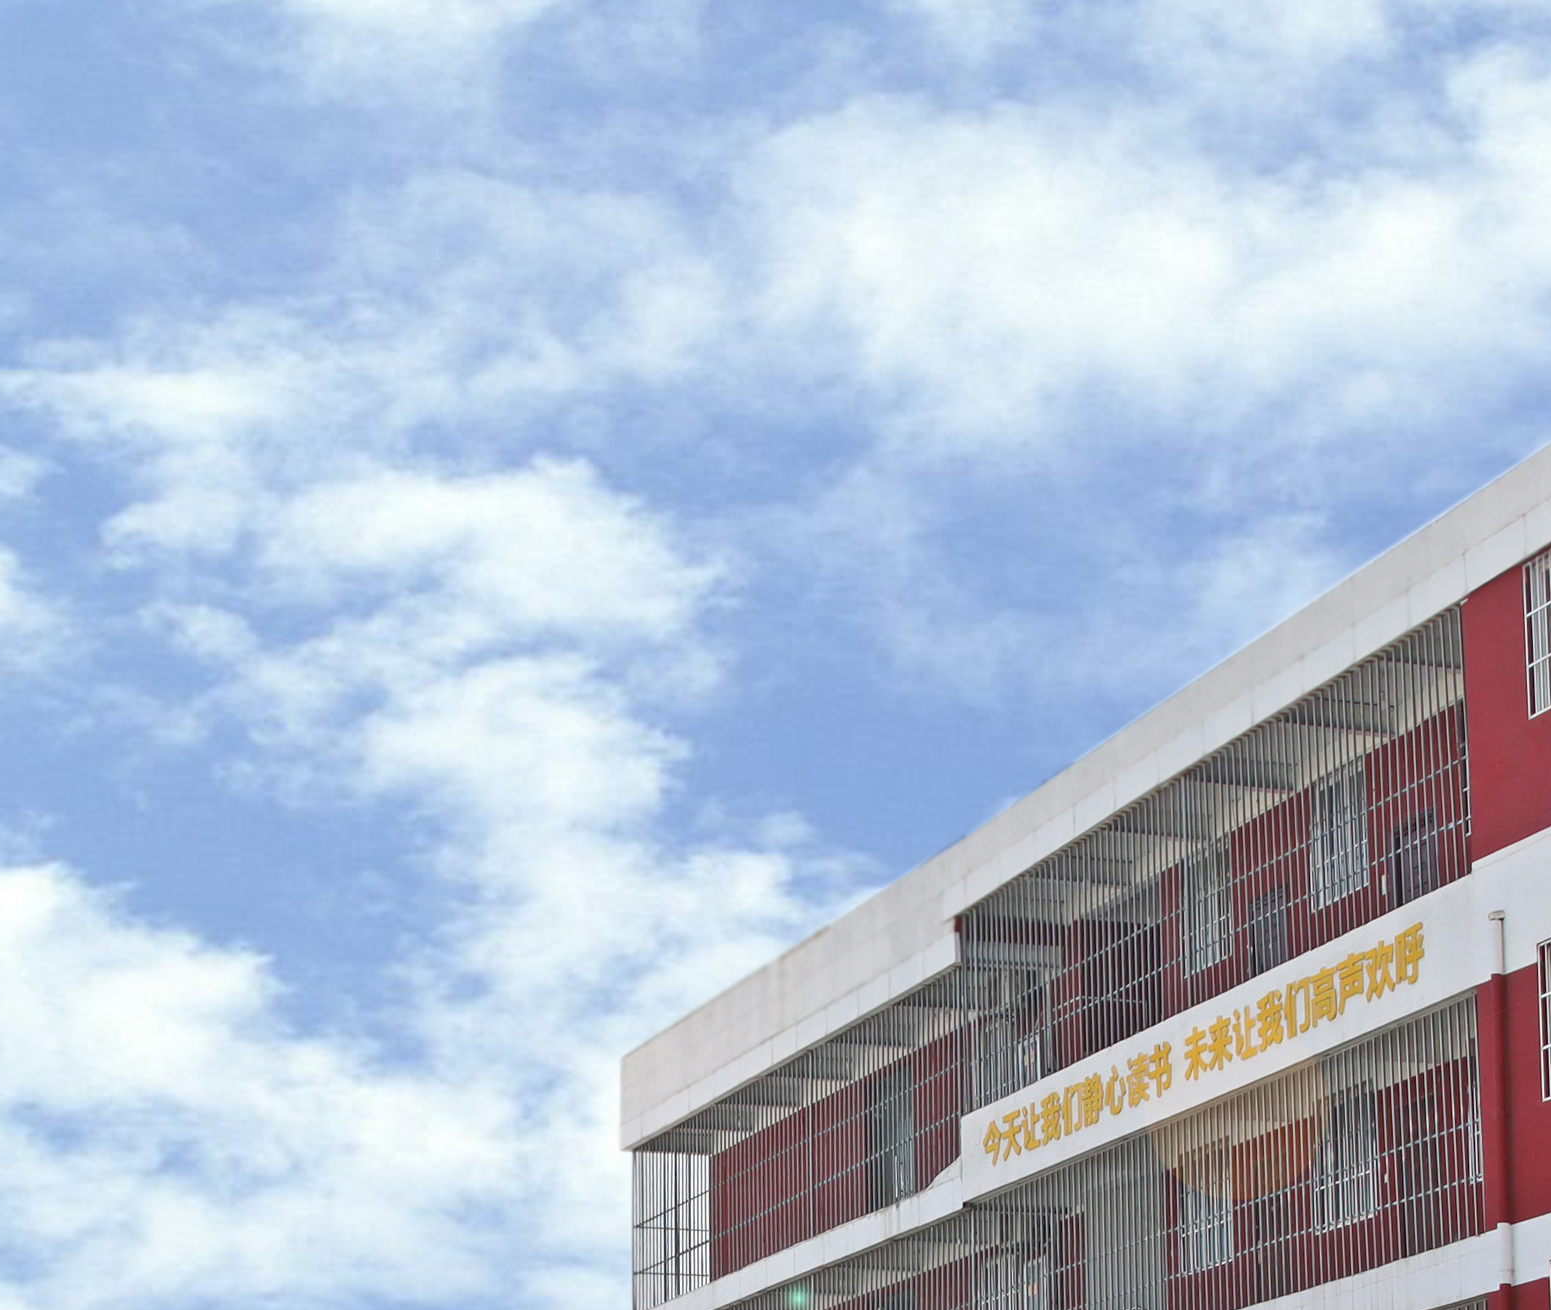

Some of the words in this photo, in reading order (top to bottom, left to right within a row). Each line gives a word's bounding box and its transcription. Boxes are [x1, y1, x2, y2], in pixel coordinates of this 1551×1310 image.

[981, 1040, 1173, 1166] 今天让我们静心读书
[1183, 921, 1426, 1081] 未来让我们高声欢呼
